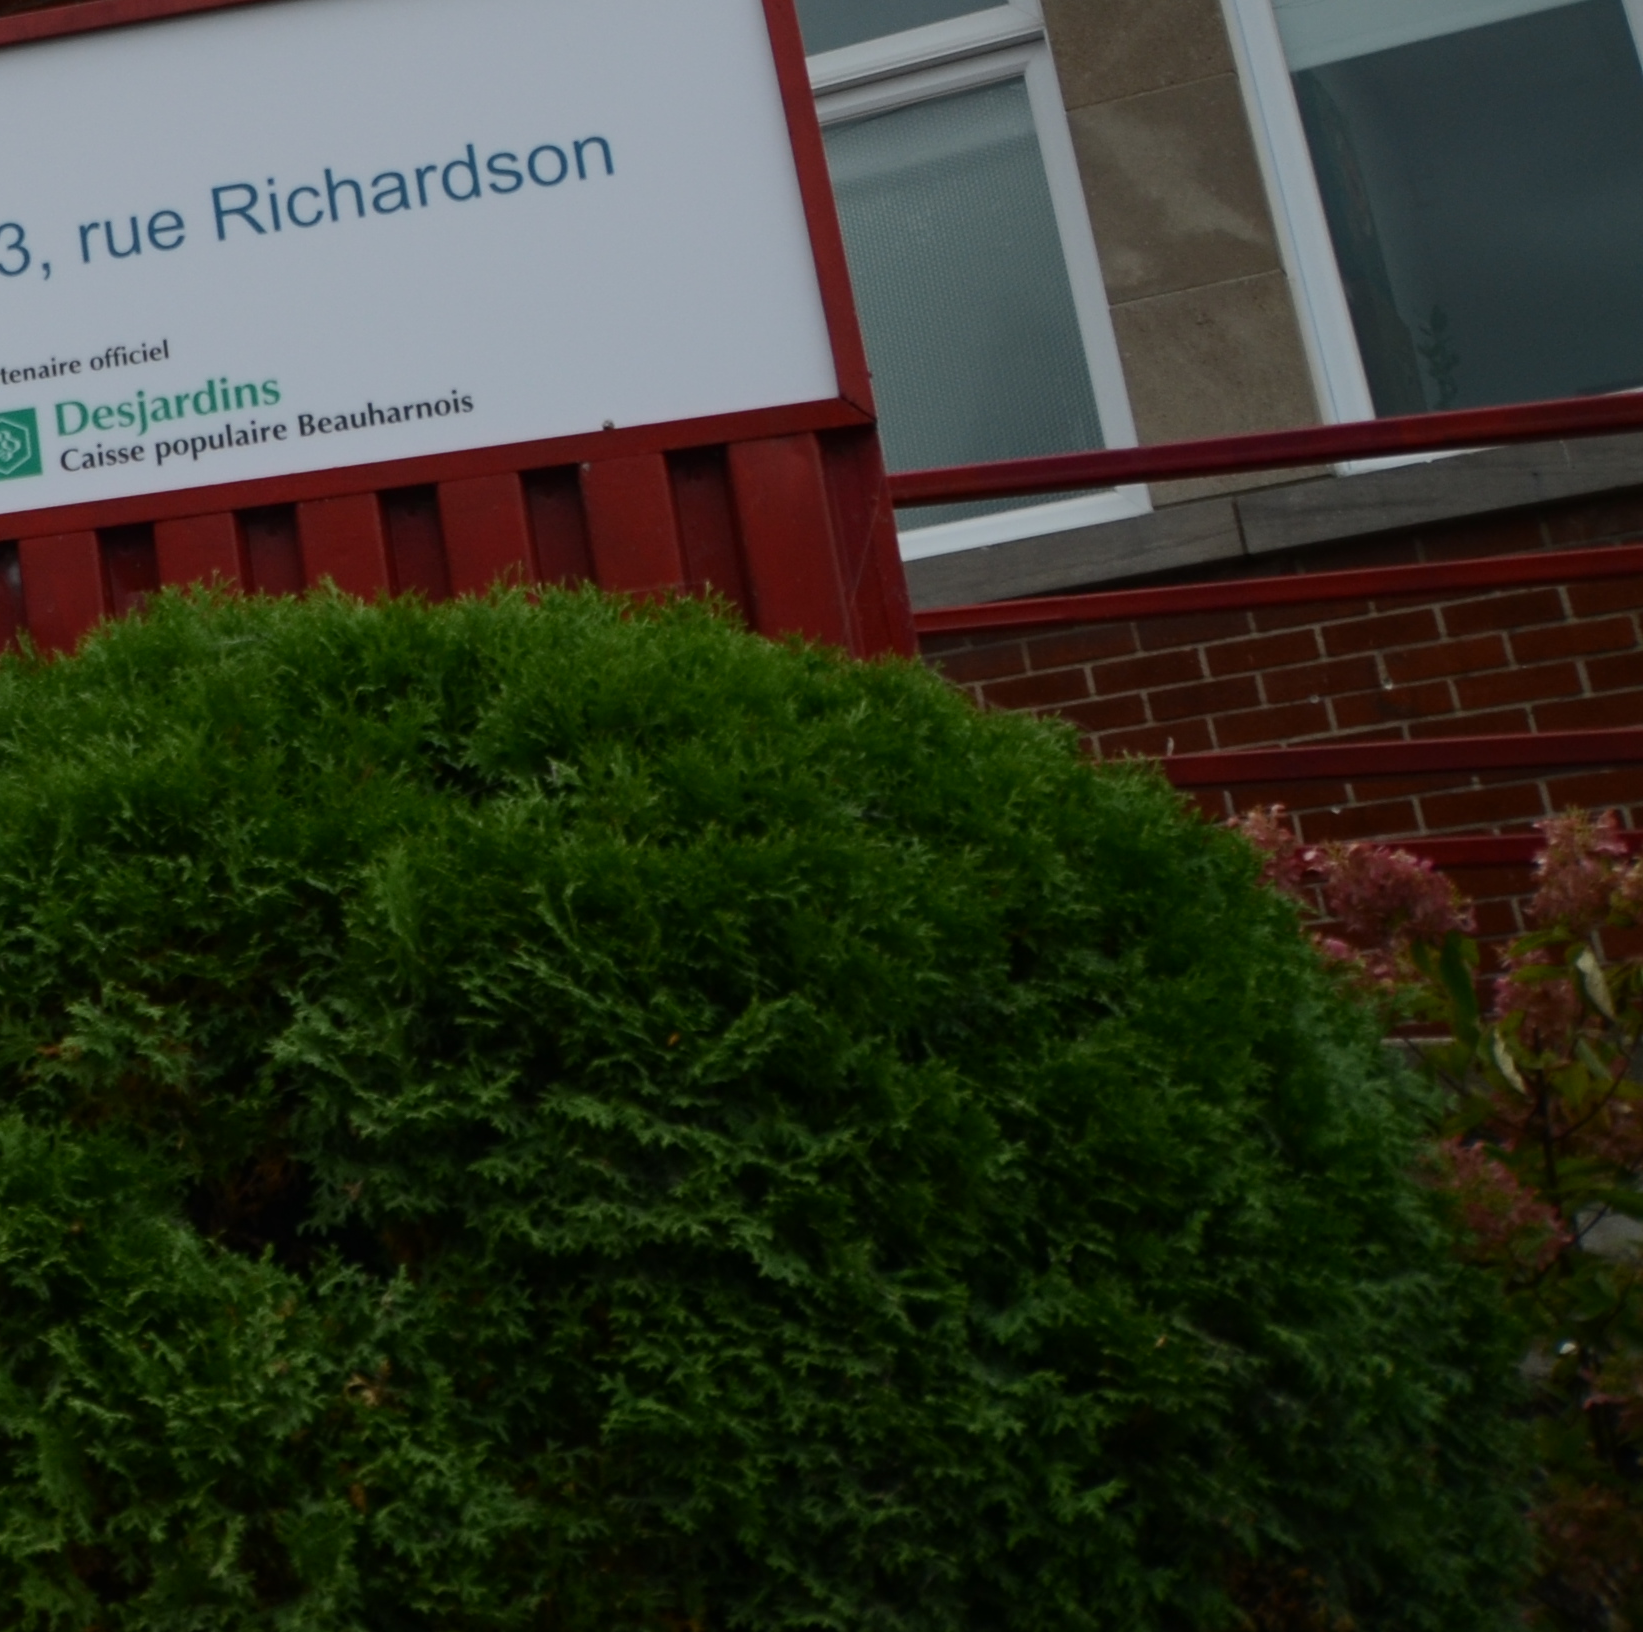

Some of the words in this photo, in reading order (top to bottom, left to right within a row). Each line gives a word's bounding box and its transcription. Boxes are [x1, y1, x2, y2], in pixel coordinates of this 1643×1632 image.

[78, 207, 186, 264] rue
[211, 135, 615, 242] Richardson
[90, 339, 170, 372] officiel
[54, 376, 282, 438] Desjardins
[60, 444, 146, 473] Caisse
[154, 419, 288, 466] populaire
[297, 389, 474, 438] Beauharnois
